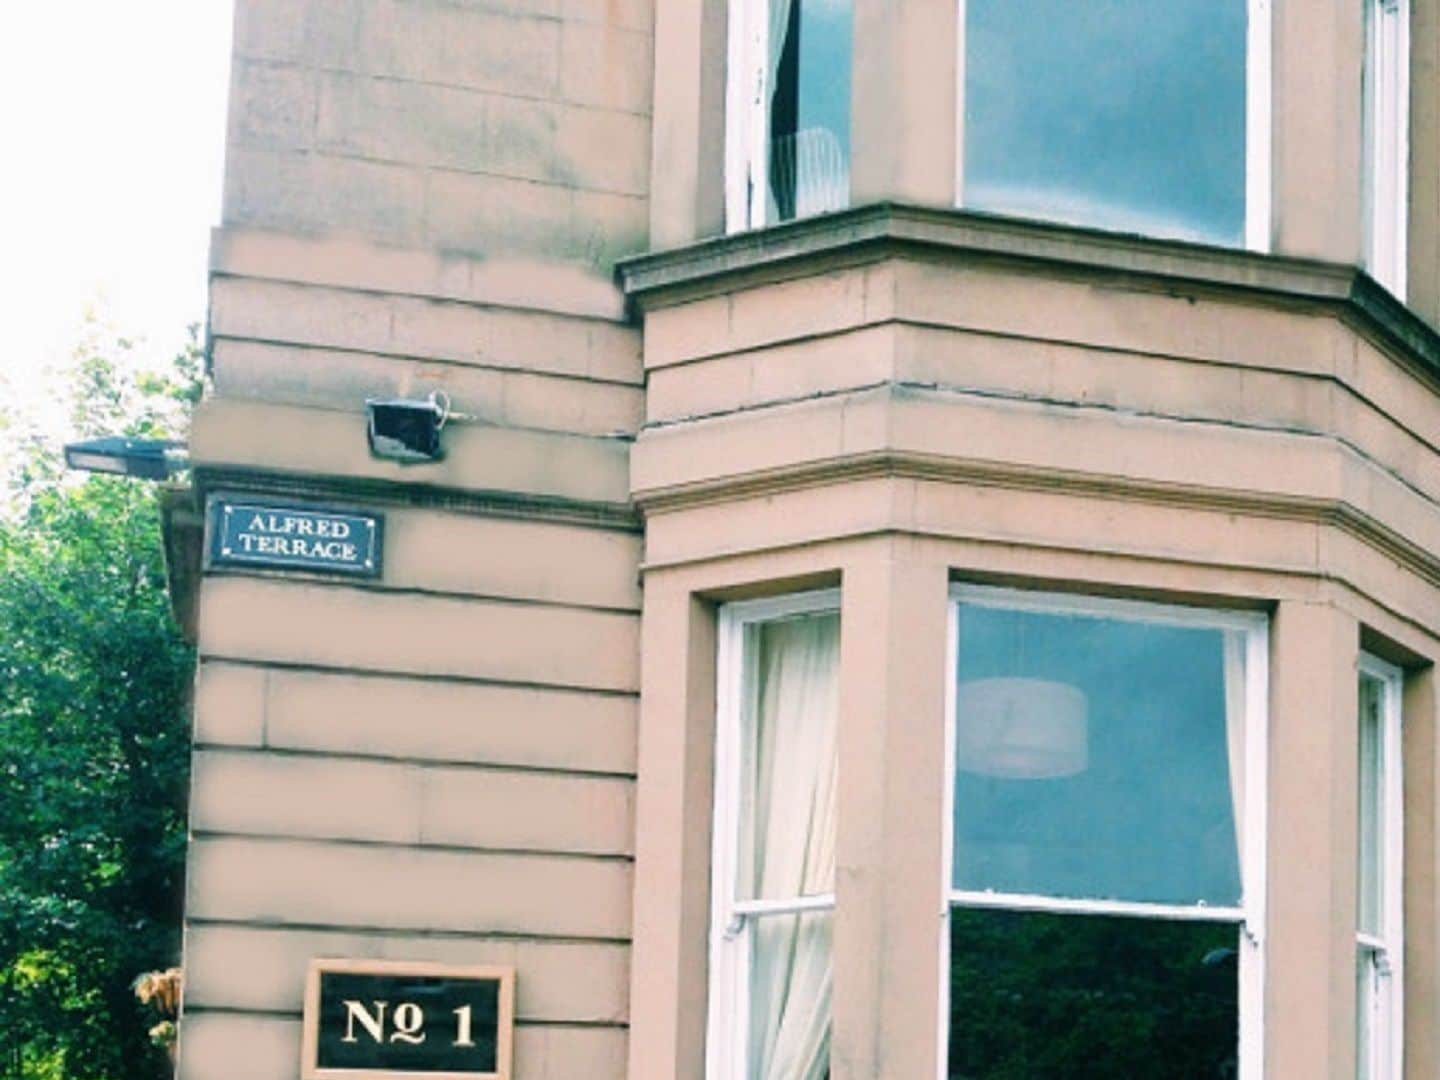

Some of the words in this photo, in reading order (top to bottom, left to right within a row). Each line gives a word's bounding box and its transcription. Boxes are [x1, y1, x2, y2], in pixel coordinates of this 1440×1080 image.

[248, 514, 350, 539] ALFRED
[238, 533, 358, 561] TERRACE
[452, 1004, 476, 1047] 1
